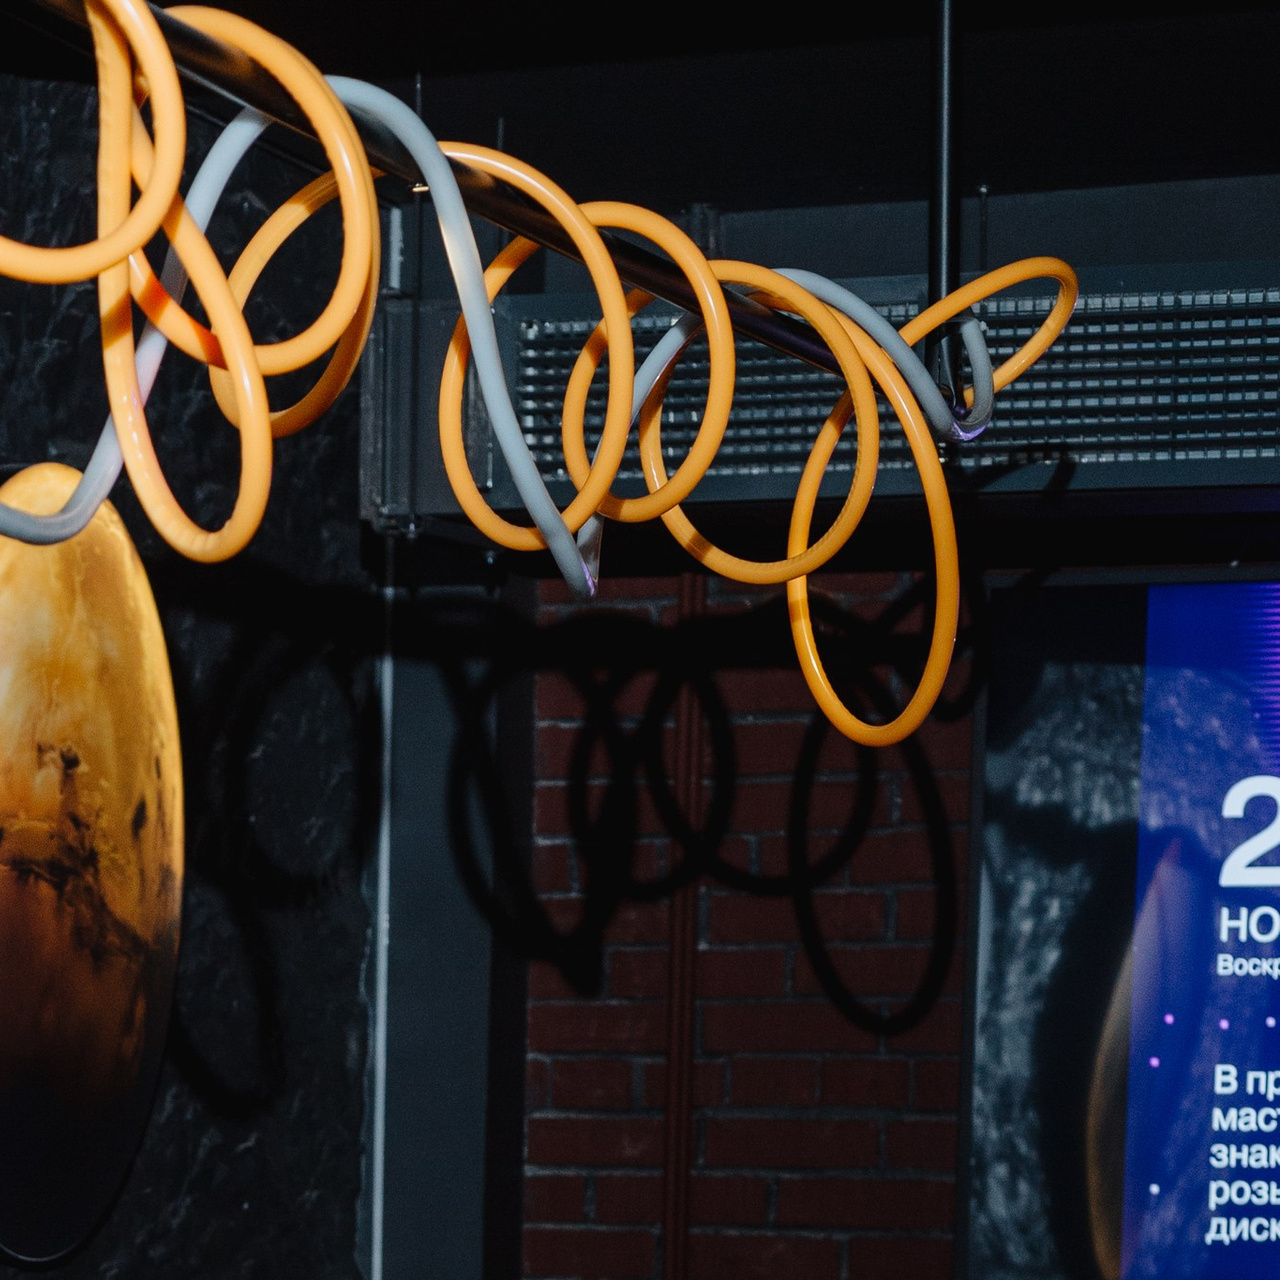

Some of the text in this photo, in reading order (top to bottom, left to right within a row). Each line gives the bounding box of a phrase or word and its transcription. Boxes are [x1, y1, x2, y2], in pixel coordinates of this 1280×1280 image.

[1219, 775, 1280, 888] 2
[1220, 905, 1280, 944] НО
[1213, 1063, 1239, 1096] В
[1211, 1107, 1280, 1133] мас
